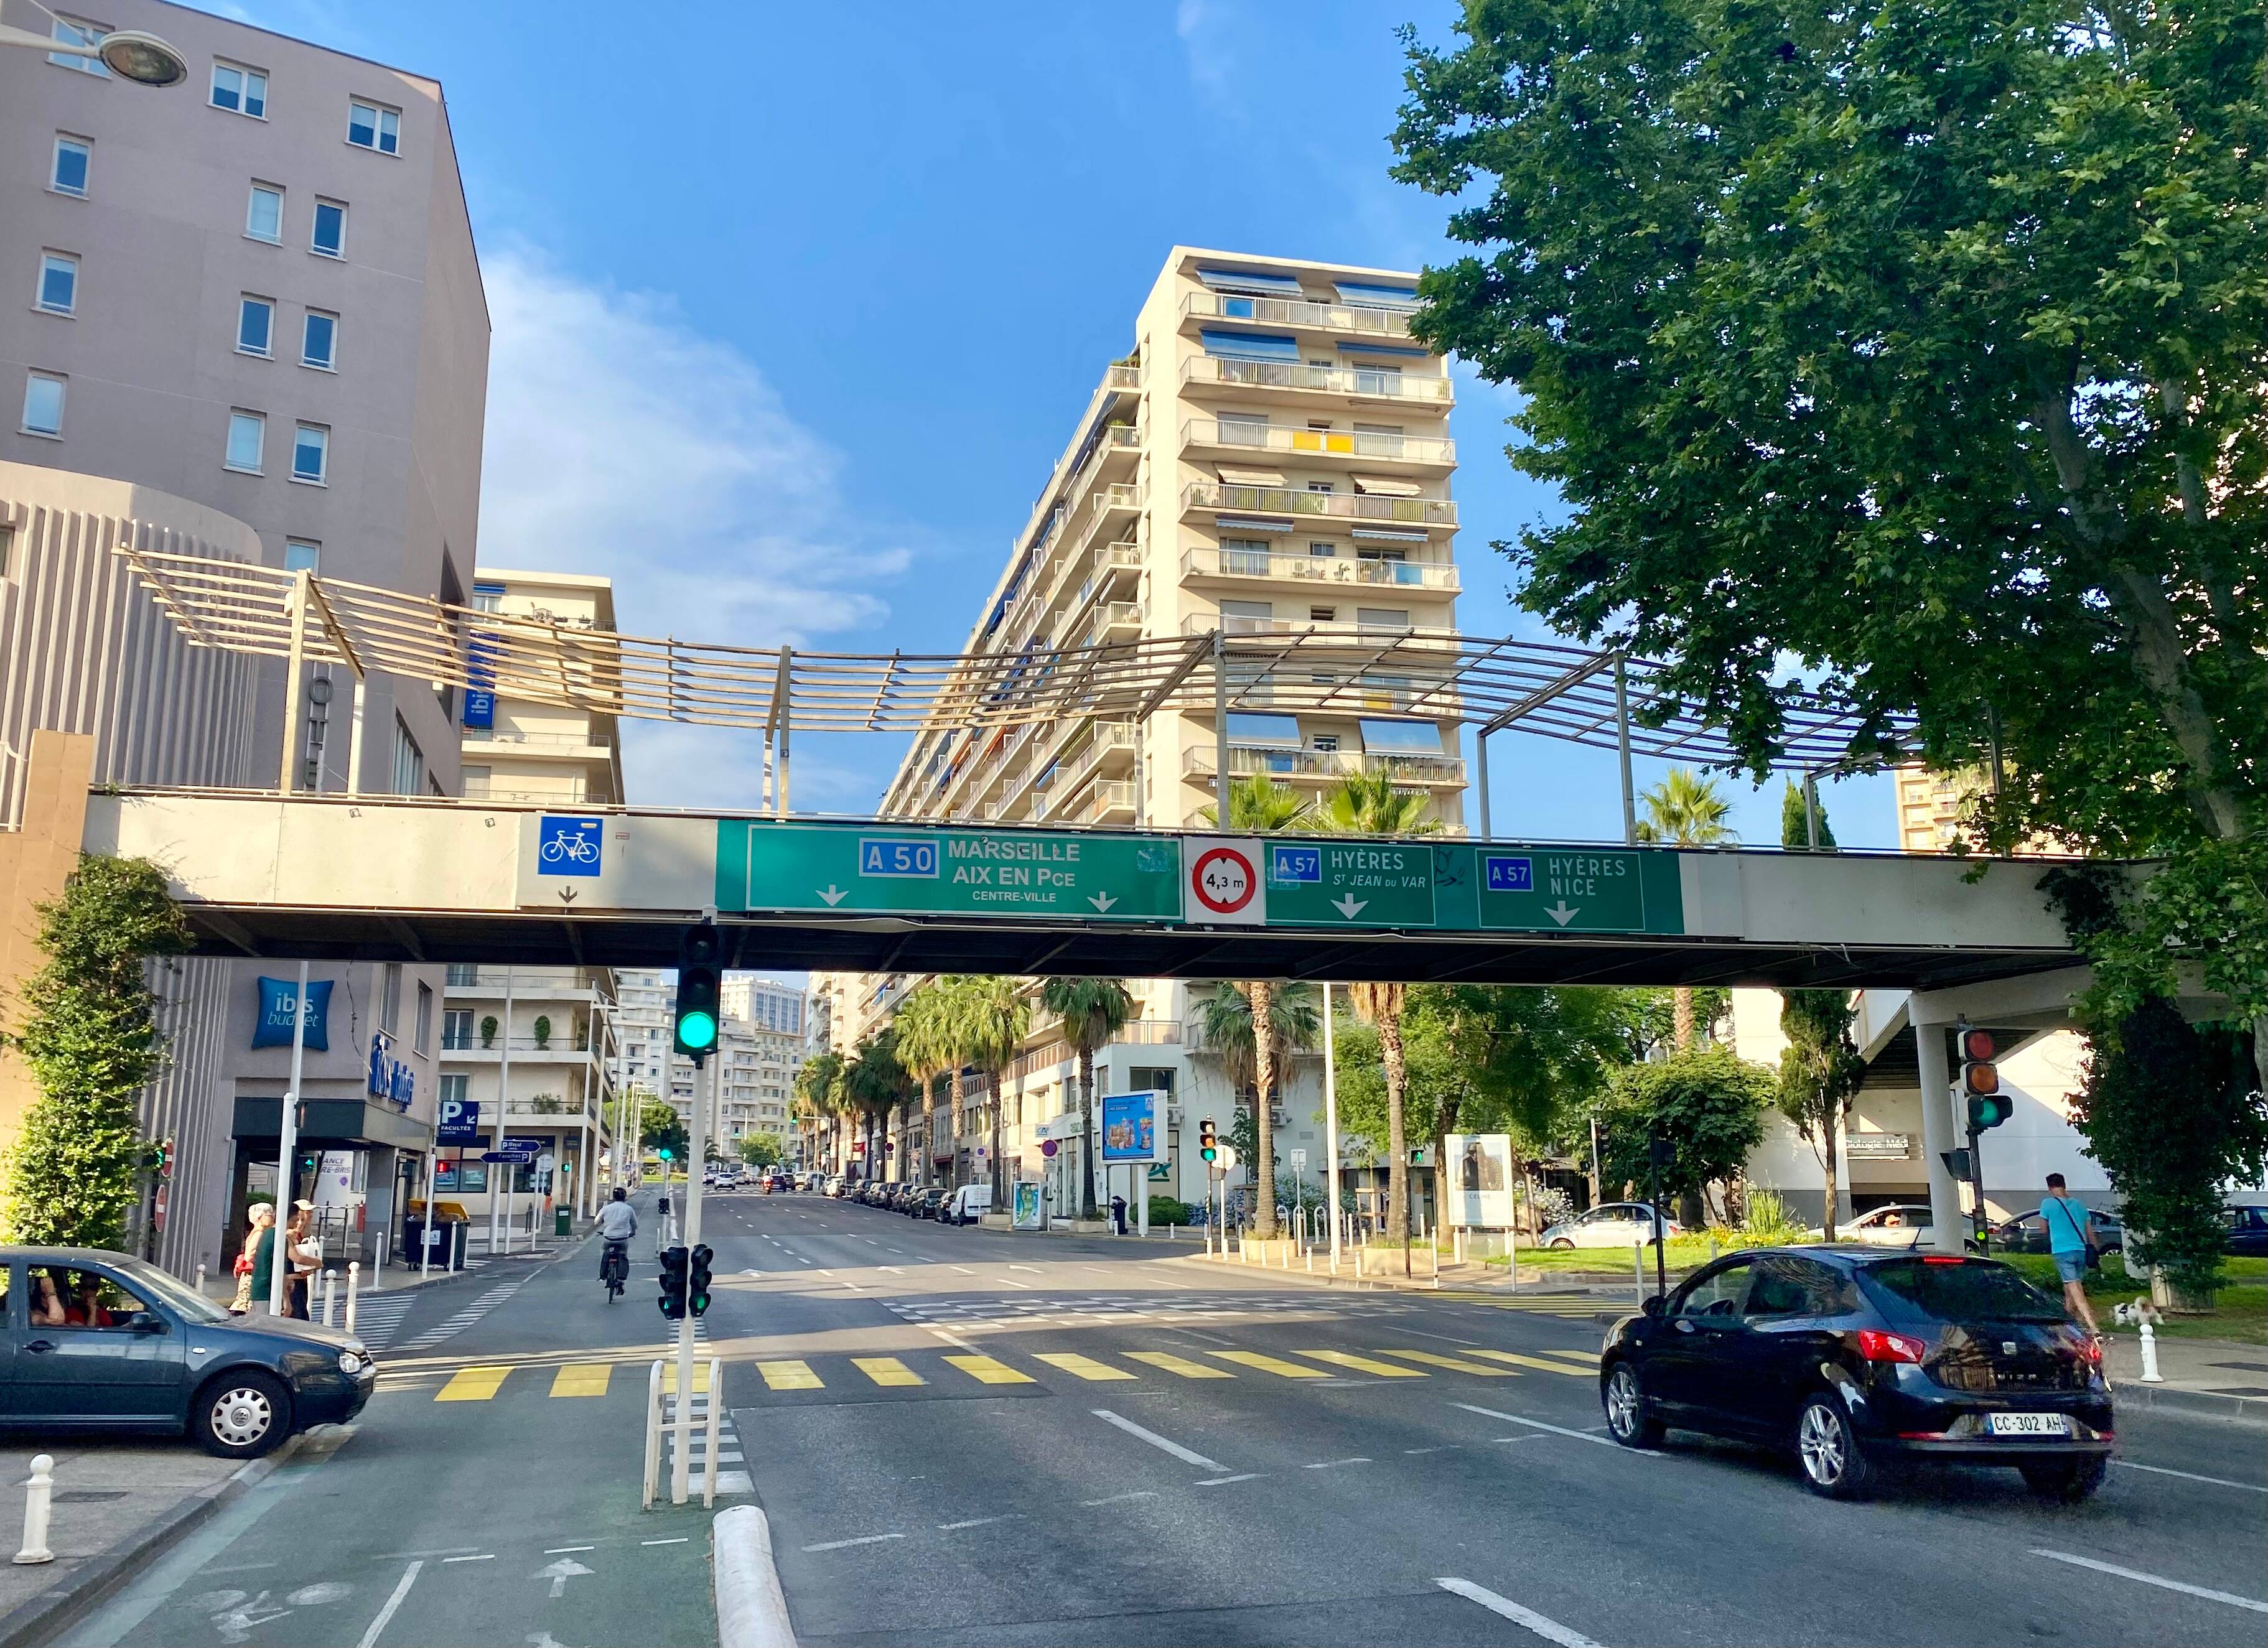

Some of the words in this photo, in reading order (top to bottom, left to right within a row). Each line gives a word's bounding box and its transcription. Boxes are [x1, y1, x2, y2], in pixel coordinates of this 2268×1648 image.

[470, 689, 490, 714] ibi
[867, 846, 884, 870] A
[894, 846, 932, 871] 50
[948, 840, 1080, 862] MARSEILLE
[1331, 849, 1404, 870] HYÈRES
[1279, 857, 1289, 872] A
[1295, 857, 1316, 872] 57
[1492, 866, 1502, 882] A
[1508, 867, 1528, 882] 57
[1549, 855, 1626, 877] HYÈRES
[952, 865, 992, 885] AIX
[999, 867, 1029, 886] EN
[1206, 873, 1228, 890] 4,3
[1233, 880, 1244, 888] m
[1350, 874, 1382, 887] JEAN
[1385, 879, 1397, 887] DU
[1401, 876, 1426, 888] VAR
[972, 890, 1057, 902] CENTRE-VILLE
[1550, 878, 1596, 896] NICE
[276, 992, 314, 1013] ibs
[268, 1011, 319, 1027] budet
